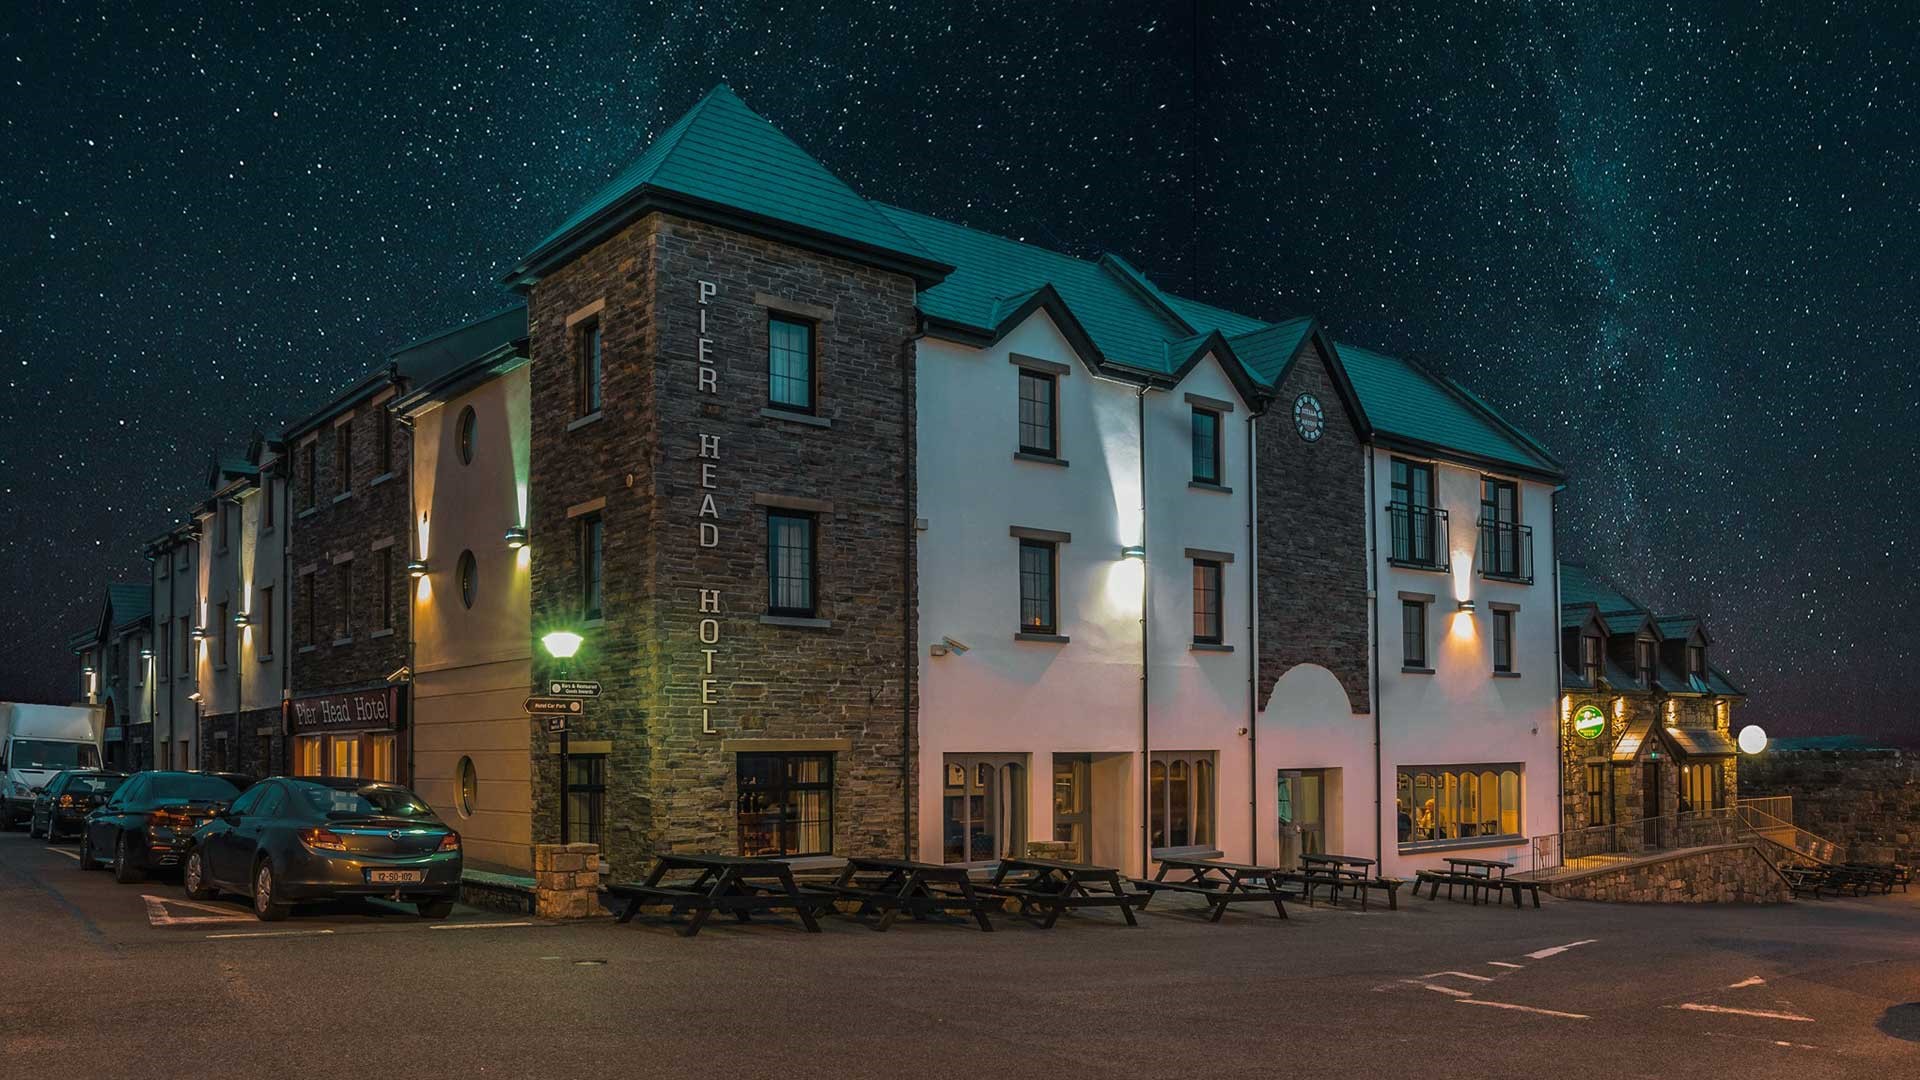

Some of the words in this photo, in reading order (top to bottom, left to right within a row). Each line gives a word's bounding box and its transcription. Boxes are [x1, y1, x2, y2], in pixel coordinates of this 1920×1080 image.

[698, 280, 717, 393] PIER
[699, 433, 720, 548] HEAD
[295, 703, 317, 725] Pier
[320, 698, 351, 723] Head
[354, 693, 389, 721] Hotel
[699, 589, 720, 734] HOTEL
